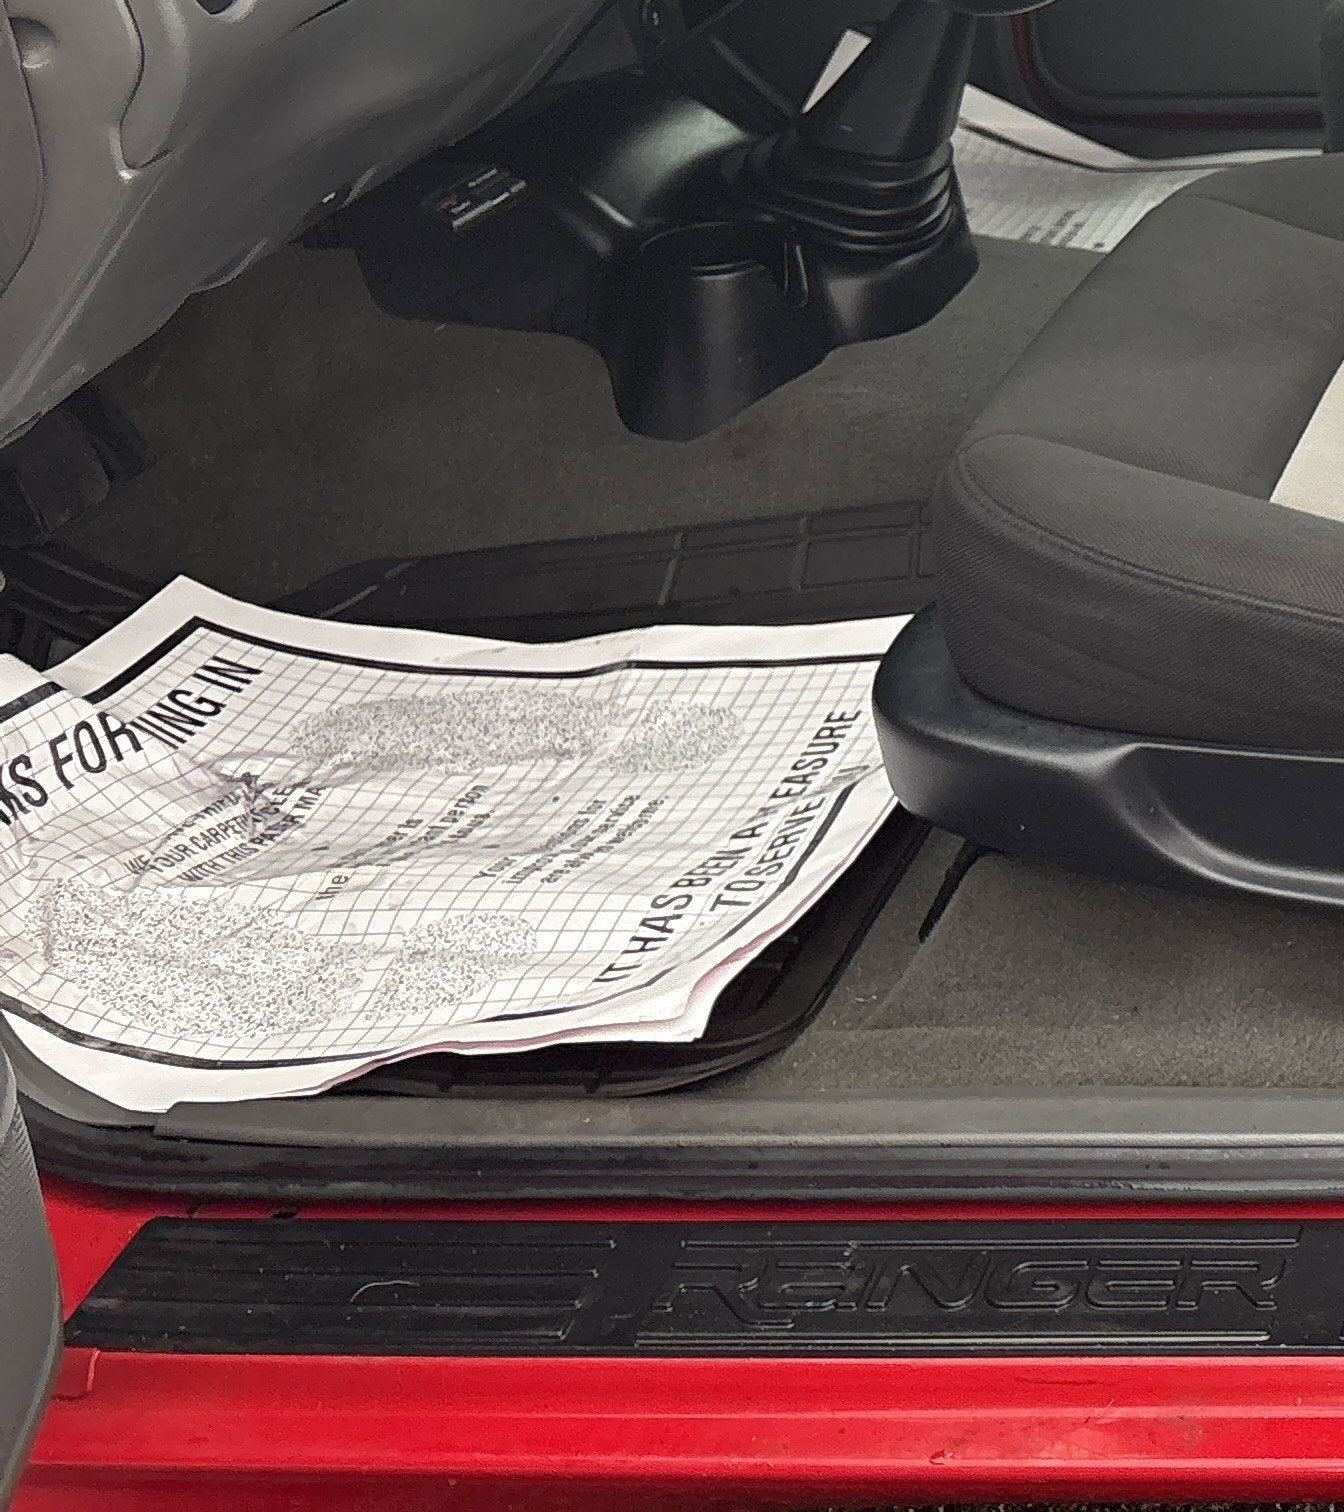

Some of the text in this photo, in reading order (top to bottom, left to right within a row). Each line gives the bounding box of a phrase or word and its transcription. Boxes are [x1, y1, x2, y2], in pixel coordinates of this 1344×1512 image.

[49, 711, 144, 790] FOR
[191, 656, 263, 693] IN
[151, 844, 197, 873] YOUR
[177, 859, 225, 883] WITH
[219, 842, 260, 864] THIS
[315, 874, 350, 901] the
[709, 796, 827, 912] TO SERVE
[592, 962, 642, 983] IT
[621, 894, 694, 955] HAS
[729, 821, 769, 840] A
[650, 1257, 1288, 1329] RANGER
